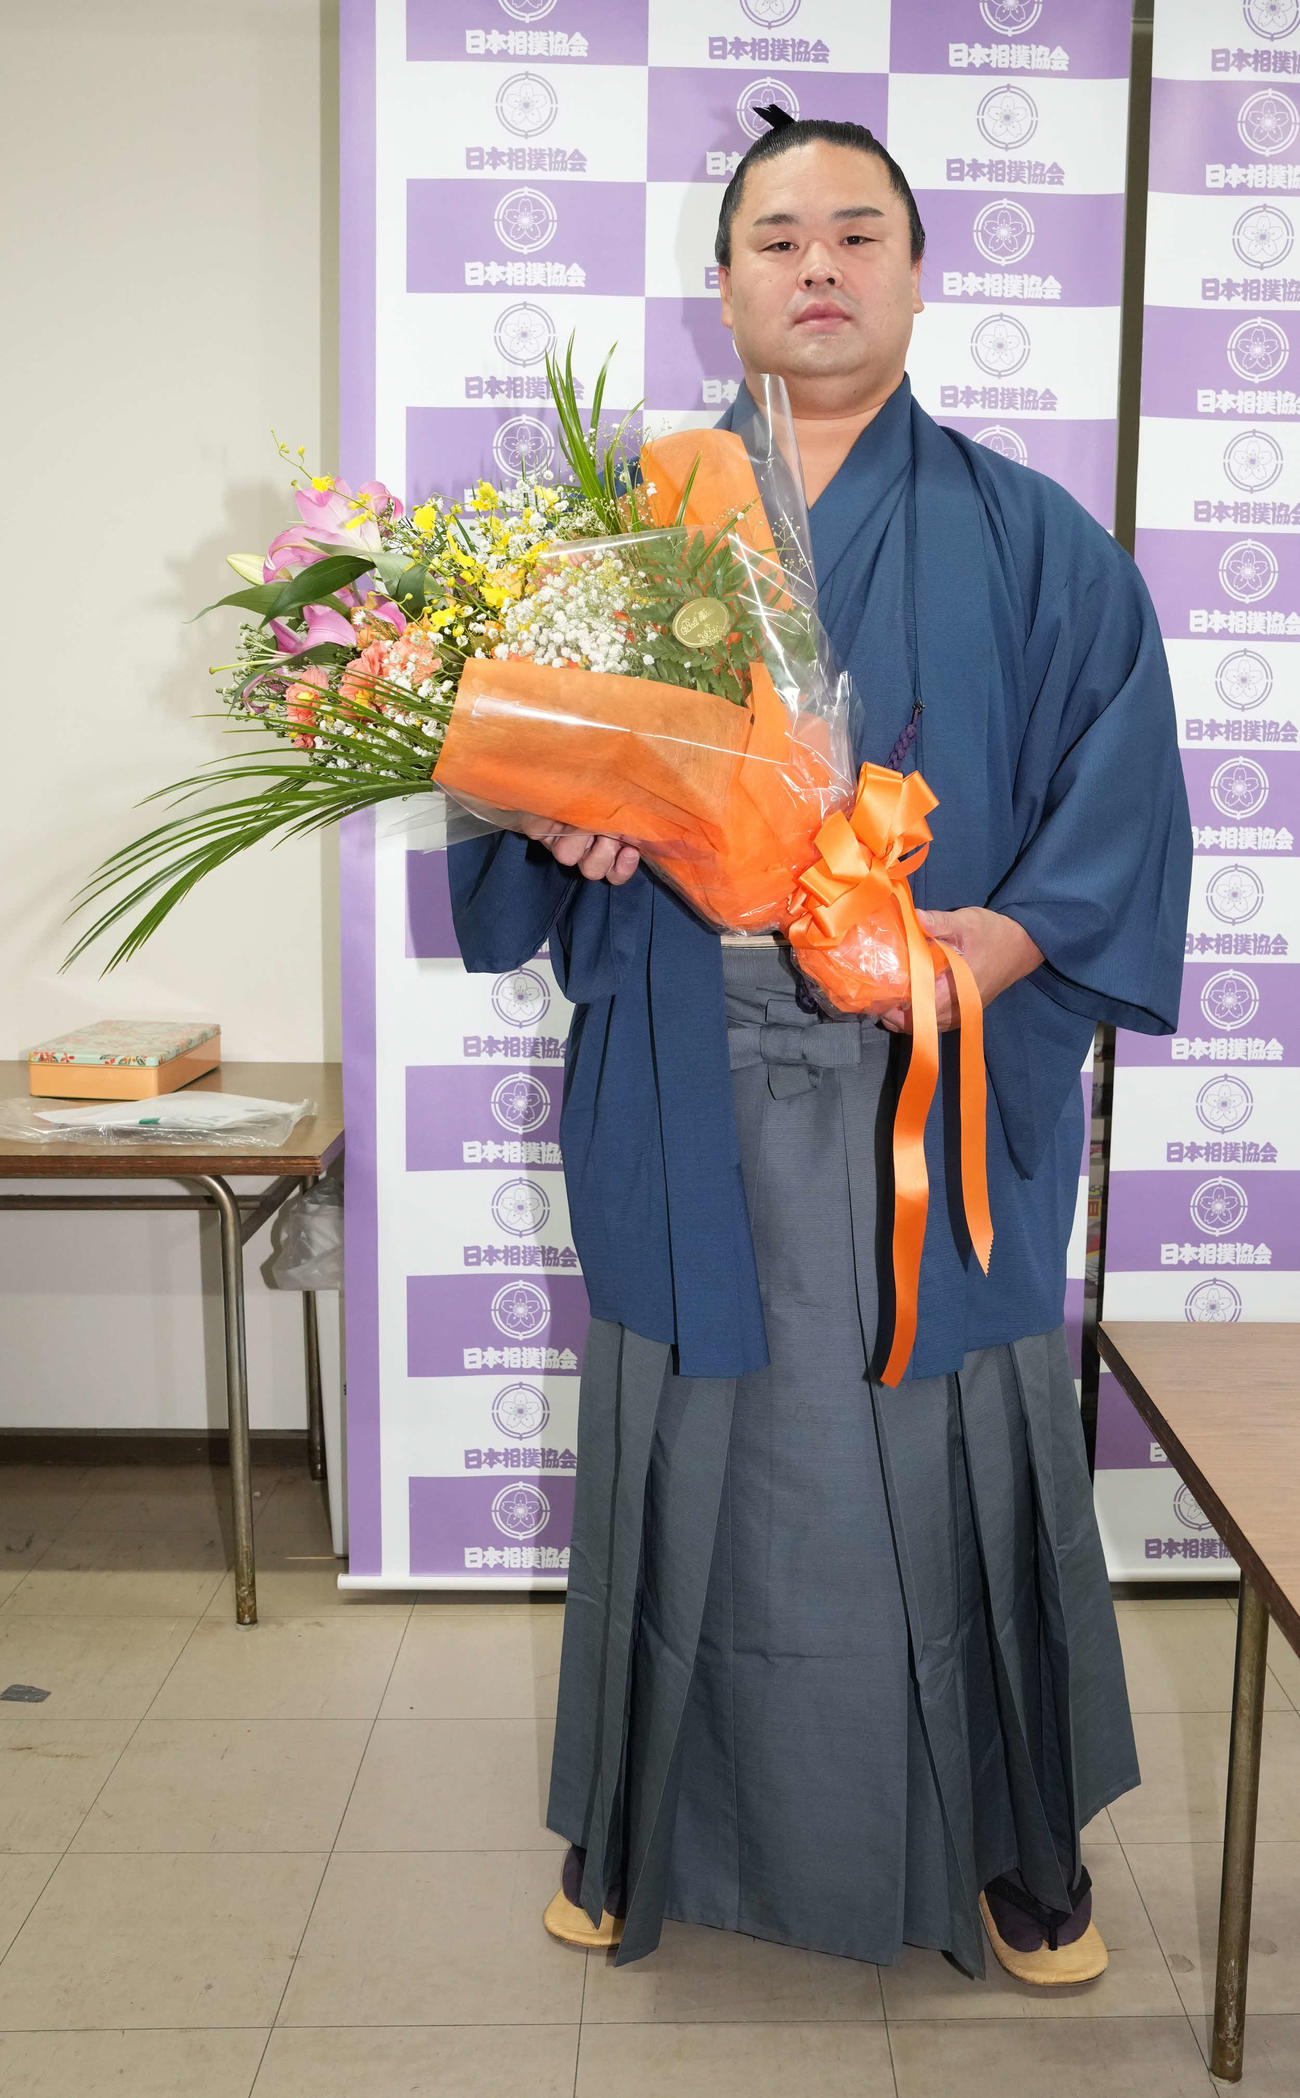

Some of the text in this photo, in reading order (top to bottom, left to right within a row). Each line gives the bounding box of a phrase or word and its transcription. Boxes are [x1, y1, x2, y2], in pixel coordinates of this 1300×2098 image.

[465, 30, 589, 57] 日本相撲協会
[708, 36, 830, 63] 日本相撲協会
[949, 43, 1070, 71] 日本相撲協会
[465, 146, 588, 172] 日本相撲協会
[946, 158, 1065, 185] 日本相撲協会
[464, 261, 586, 288] 日本相撲協会
[942, 272, 1062, 300] 日本相撲協会
[940, 385, 1058, 411] 日本相撲協会
[1197, 389, 1300, 415] 日本相撲協
[1189, 609, 1300, 635] 日本相撲協会
[1185, 719, 1299, 743] 日本相撲協会
[1191, 826, 1295, 850] 本相撲協会
[1171, 1037, 1284, 1061] 日本相撲協会
[463, 1141, 563, 1164] 日本相撲協
[1166, 1141, 1278, 1163] 日本相撲協会
[463, 1246, 578, 1268] 日本相撲協会
[1160, 1243, 1272, 1265] 日本相撲協会
[463, 1348, 578, 1370] 日本相撲協会
[464, 1448, 577, 1469] 日本相撲協会
